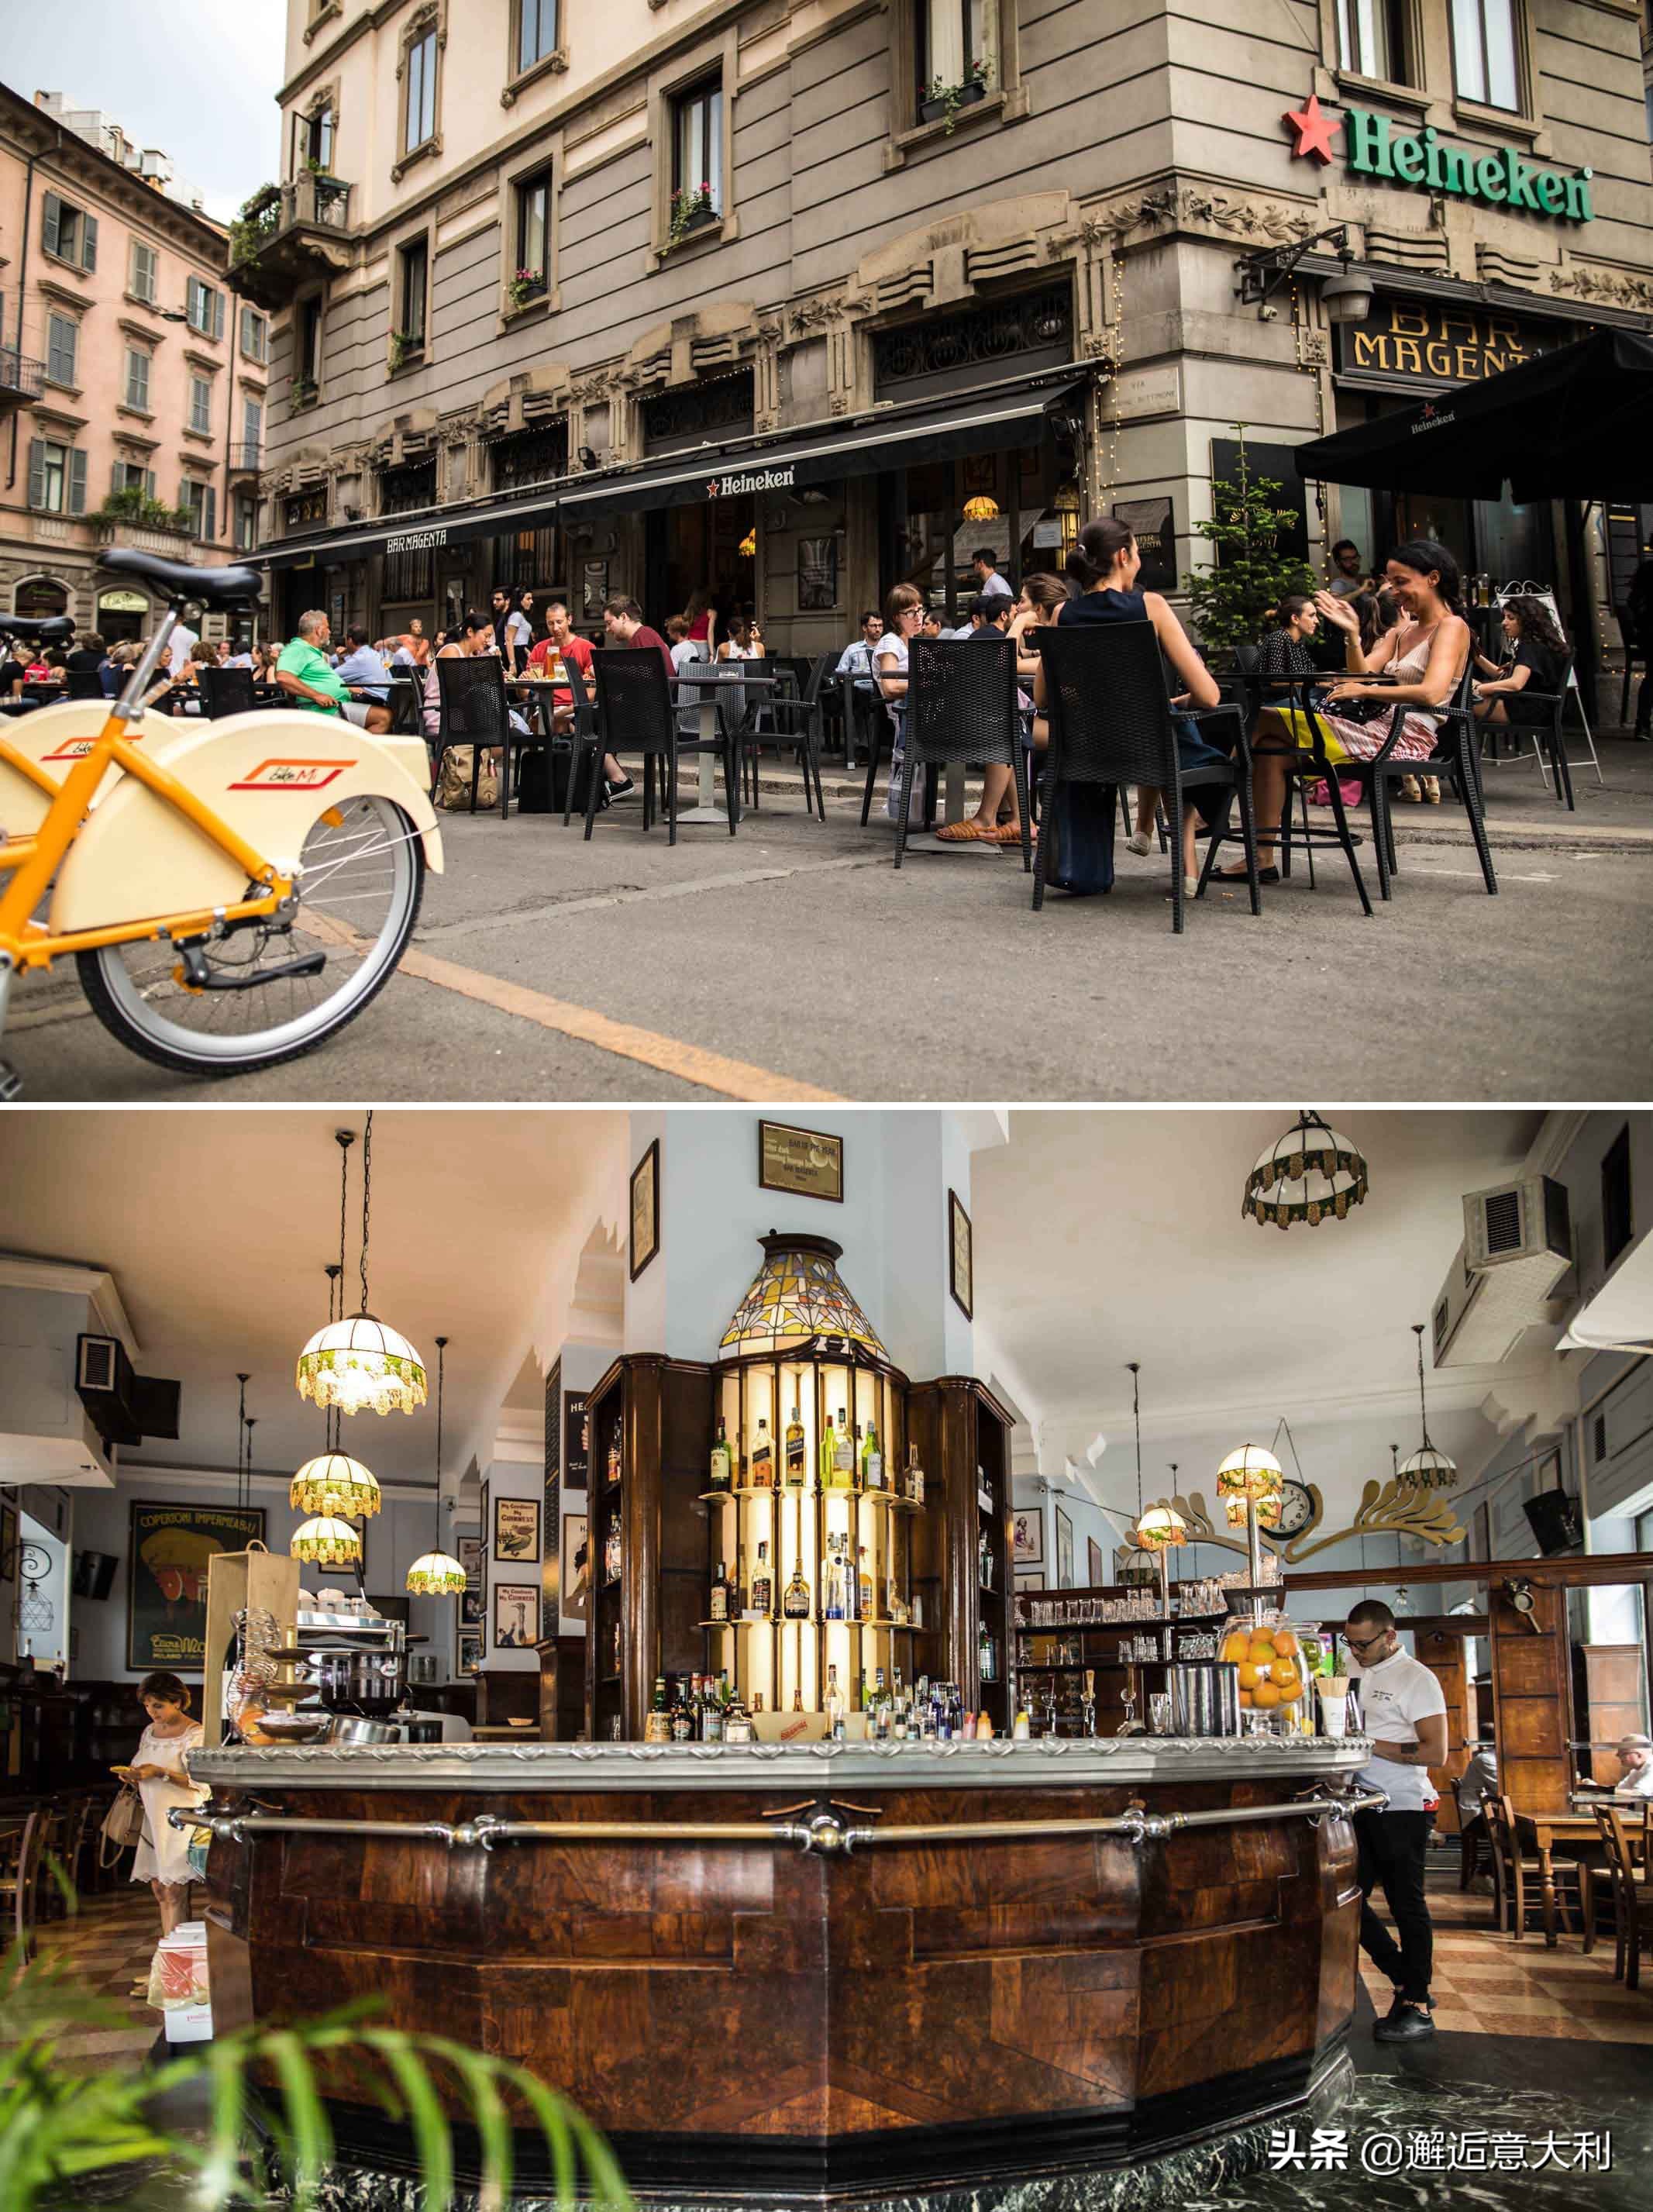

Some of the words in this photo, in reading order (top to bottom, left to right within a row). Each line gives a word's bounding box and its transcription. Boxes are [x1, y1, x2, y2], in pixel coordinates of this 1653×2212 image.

[1345, 109, 1595, 223] Heineken
[1389, 301, 1524, 351] BAR
[1353, 331, 1531, 380] MAGENT
[1410, 411, 1455, 435] Heineken
[720, 465, 795, 496] Heineken
[387, 537, 405, 553] BAR
[405, 529, 447, 550] MAGENTA
[570, 1402, 587, 1413] HE
